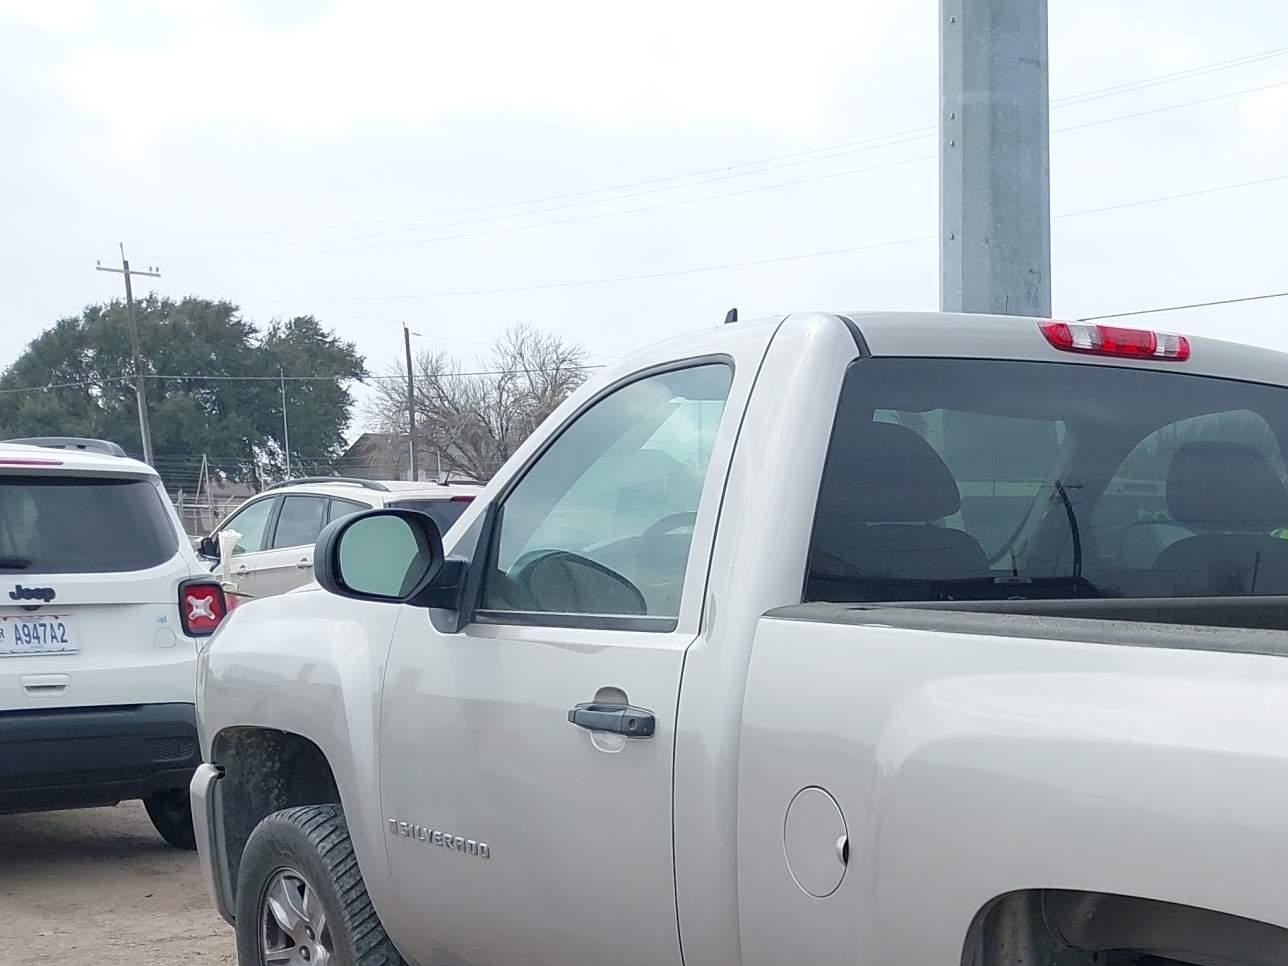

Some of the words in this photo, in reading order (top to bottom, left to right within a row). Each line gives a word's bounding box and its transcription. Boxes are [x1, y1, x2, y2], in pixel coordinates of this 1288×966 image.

[9, 584, 56, 603] Jeep
[14, 622, 69, 646] A947A2
[400, 821, 490, 859] SILVERADO
